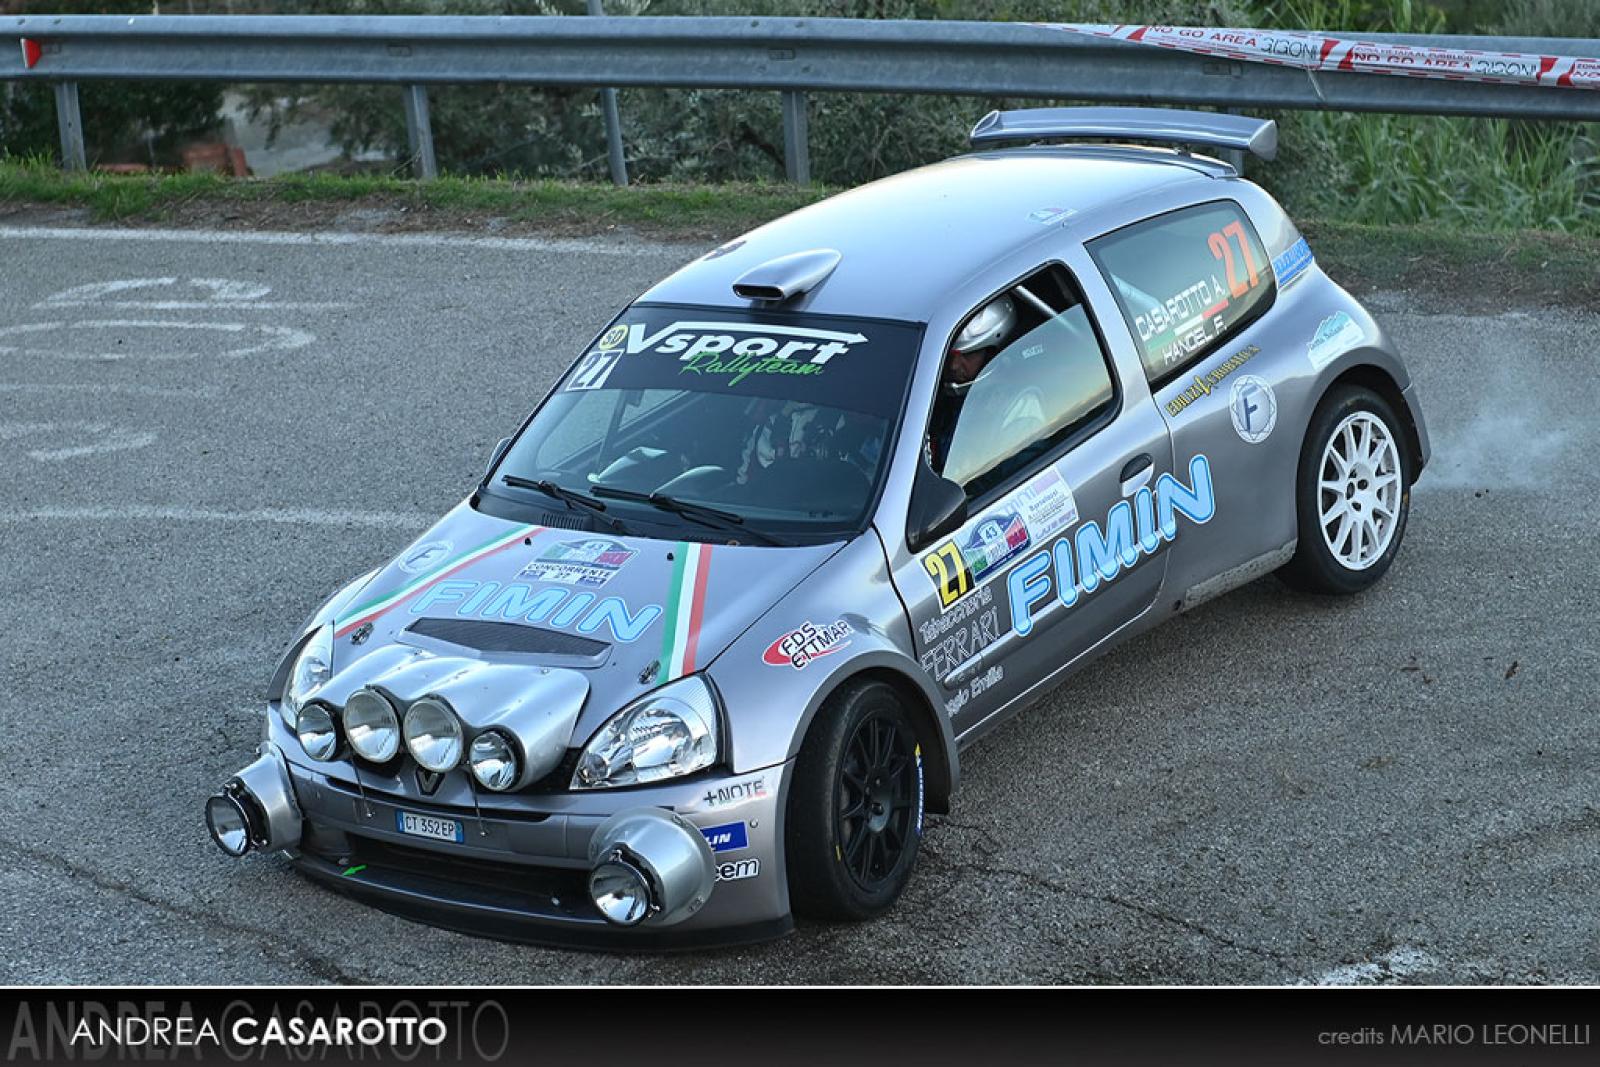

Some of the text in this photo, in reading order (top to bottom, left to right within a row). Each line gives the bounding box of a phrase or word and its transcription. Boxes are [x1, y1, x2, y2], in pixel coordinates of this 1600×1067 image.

[1179, 30, 1204, 38] GO
[1210, 33, 1256, 47] AREA
[1208, 219, 1259, 299] 27
[1135, 279, 1212, 342] CASAROTTO
[625, 321, 862, 363] Vsport
[568, 352, 621, 389] 27
[677, 350, 825, 387] Rallyteam
[1241, 383, 1259, 434] F
[985, 526, 998, 539] 43
[1008, 453, 1215, 637] FIMIN
[527, 562, 612, 578] CONCORRENTE
[924, 541, 967, 606] 27
[408, 580, 663, 644] FIMIN
[791, 621, 848, 668] ETTMAR
[919, 604, 1001, 682] FERRARI
[405, 815, 417, 830] CT
